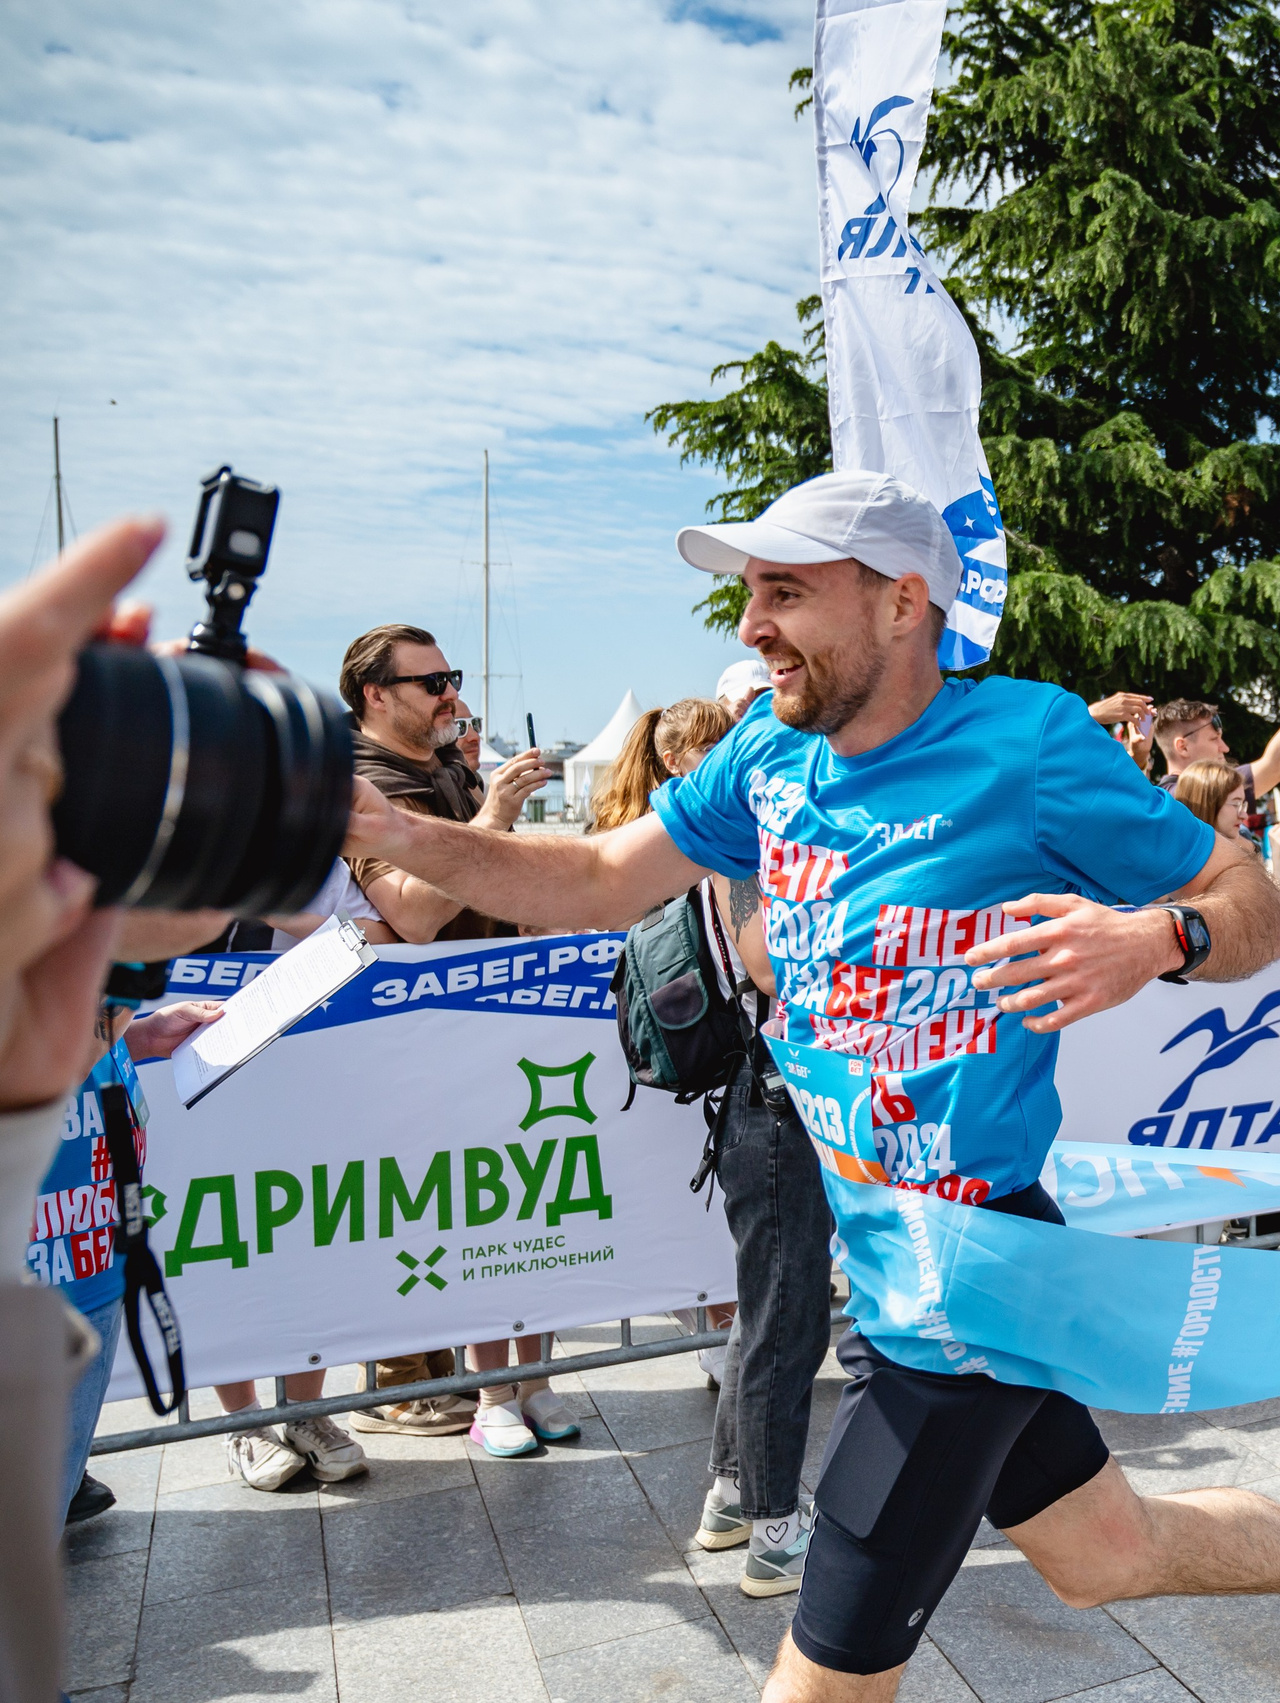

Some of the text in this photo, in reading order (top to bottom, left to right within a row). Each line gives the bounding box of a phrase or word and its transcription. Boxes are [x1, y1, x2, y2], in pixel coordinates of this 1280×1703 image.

[771, 900, 849, 961] 2024
[165, 1134, 613, 1277] ДРИМВУД
[462, 1235, 566, 1261] ПАРК ЧУДЕС
[462, 1246, 614, 1281] И ПРИКЛЮЧЕНИЙ
